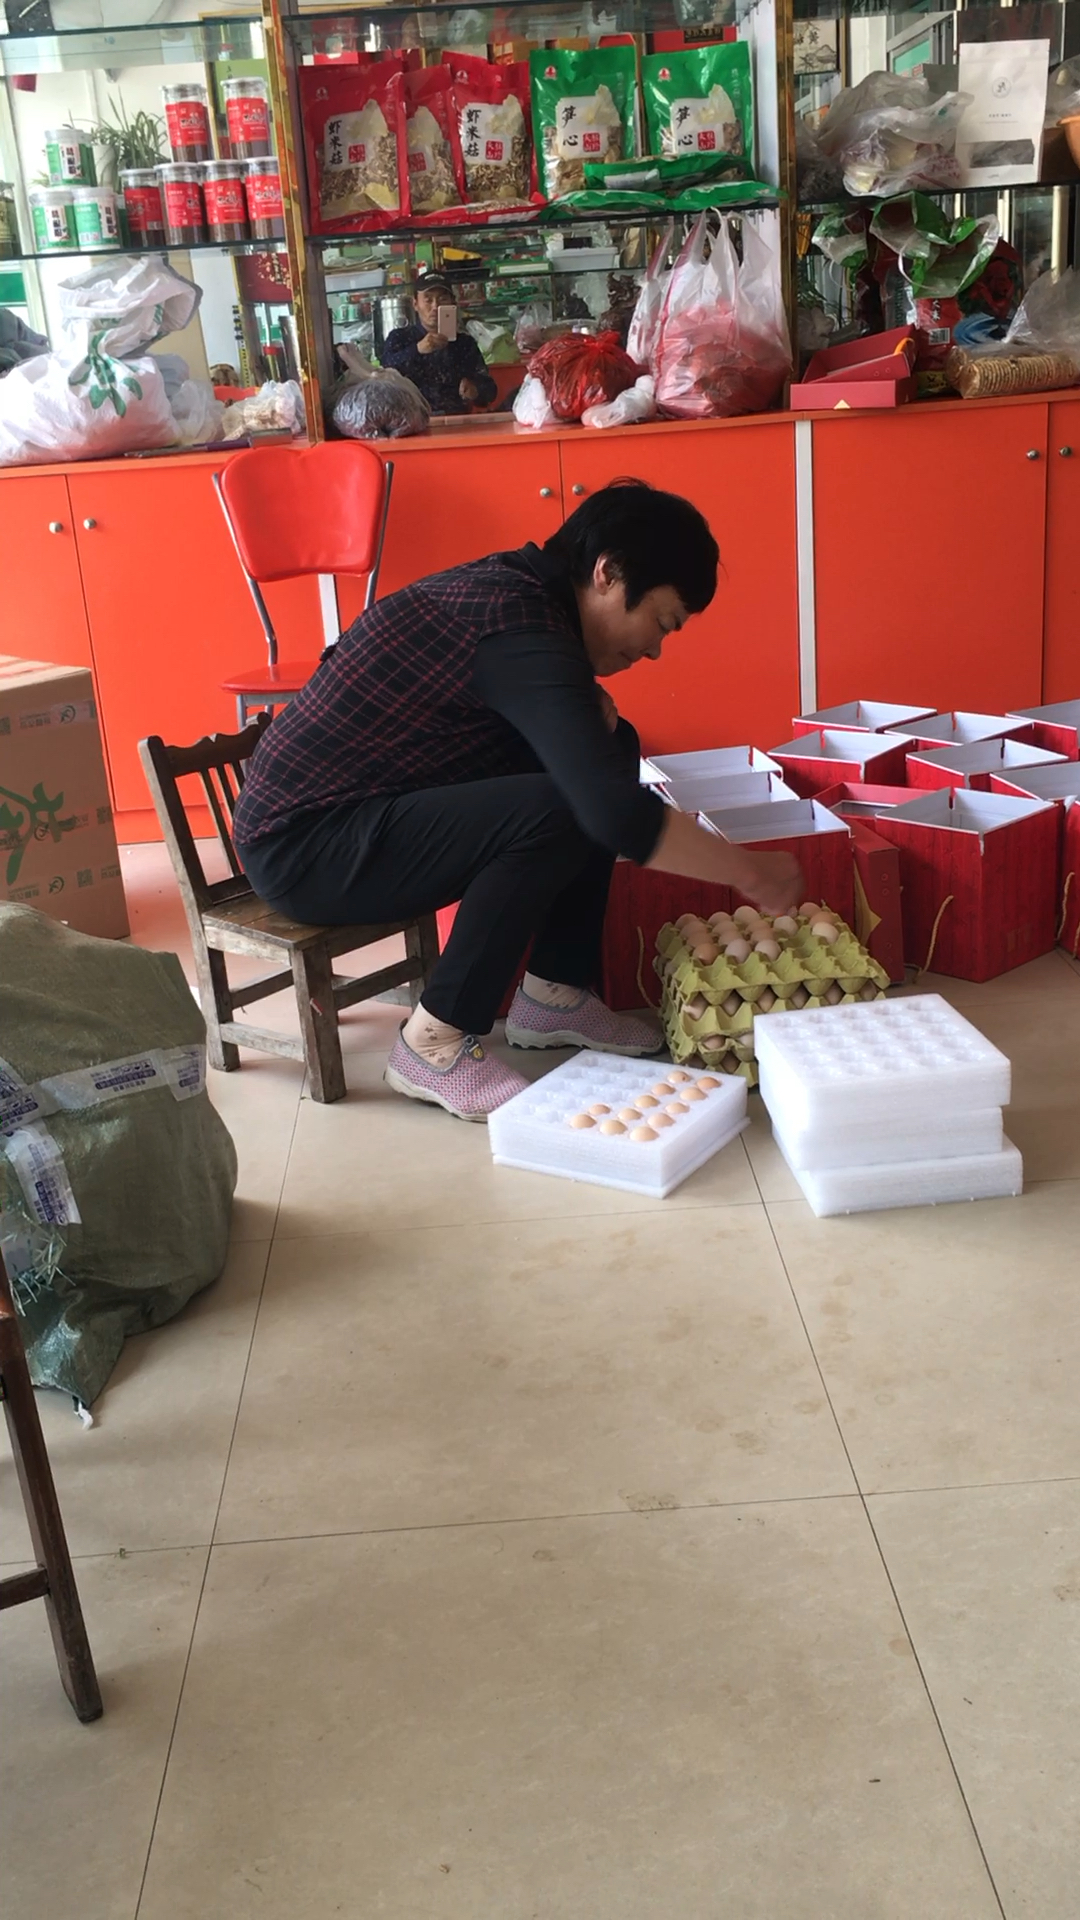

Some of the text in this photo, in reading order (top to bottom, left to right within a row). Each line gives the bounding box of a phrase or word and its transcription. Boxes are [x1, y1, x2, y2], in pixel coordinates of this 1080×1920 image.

[328, 119, 343, 165] 虾米菇
[465, 108, 482, 157] 虾米菇
[561, 105, 579, 147] 笋心
[675, 105, 693, 147] 笋心
